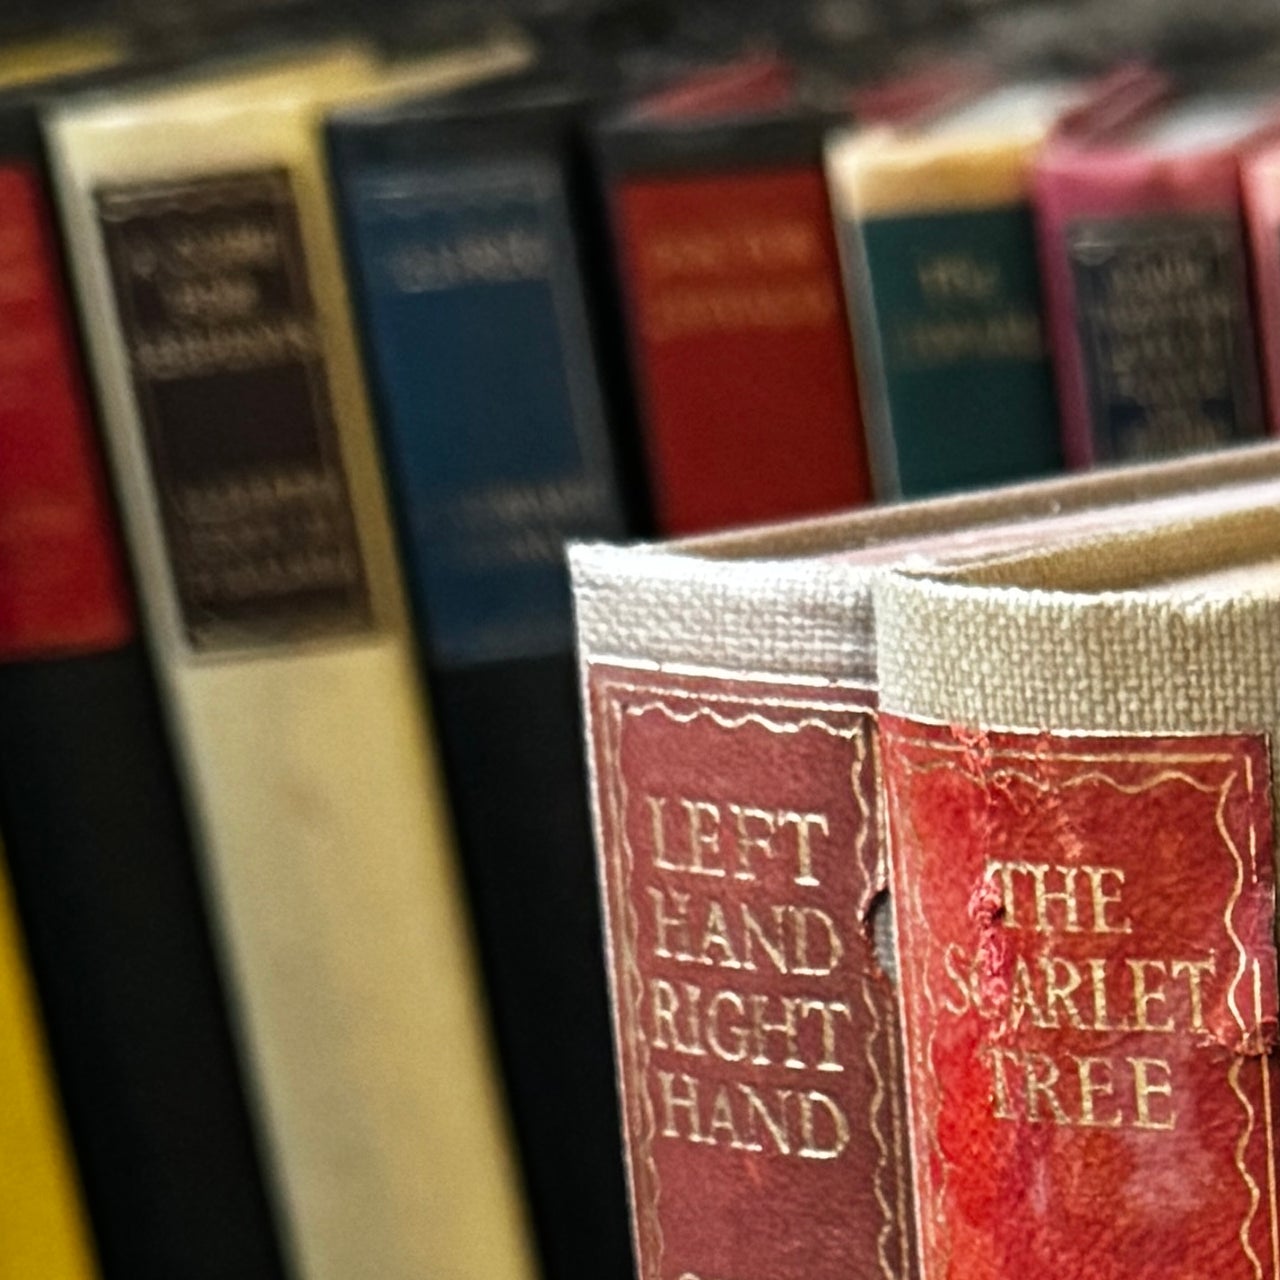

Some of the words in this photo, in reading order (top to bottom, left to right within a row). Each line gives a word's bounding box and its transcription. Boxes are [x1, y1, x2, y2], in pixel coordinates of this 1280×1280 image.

[648, 797, 829, 887] LEFT
[647, 886, 843, 975] HAND
[985, 860, 1133, 935] THE
[651, 979, 851, 1071] RIGHT
[658, 1071, 850, 1160] HAND
[986, 1047, 1179, 1130] TREE
